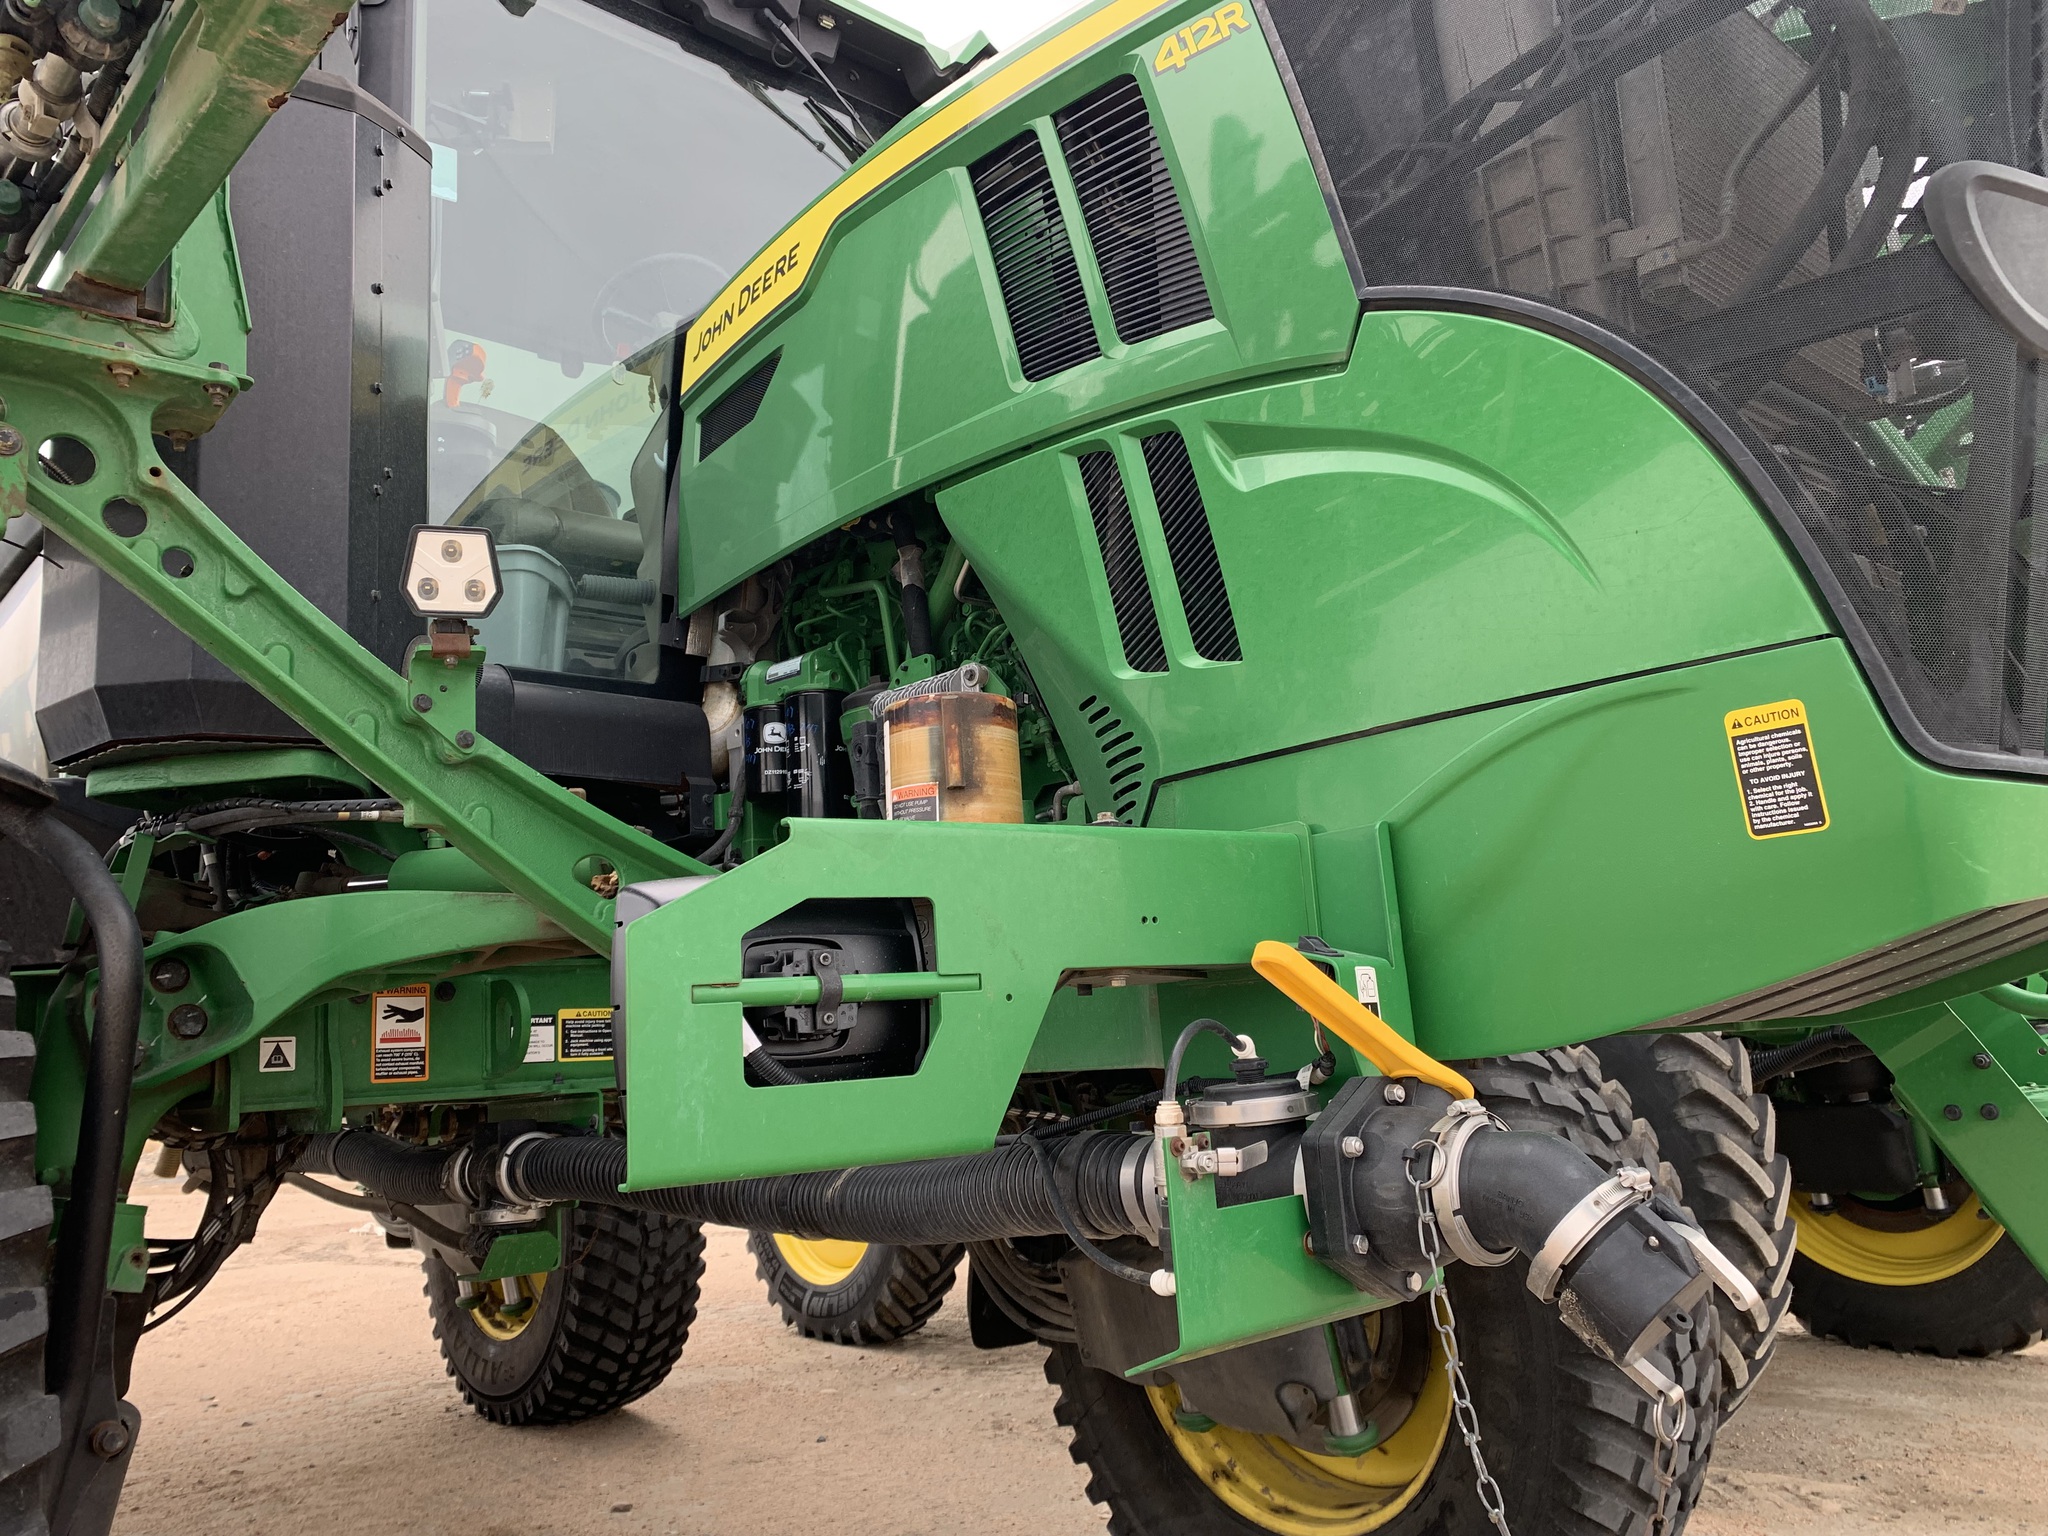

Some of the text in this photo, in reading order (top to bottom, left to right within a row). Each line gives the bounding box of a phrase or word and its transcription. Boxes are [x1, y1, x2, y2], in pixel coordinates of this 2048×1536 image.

[1152, 2, 1251, 77] 412R
[693, 242, 800, 363] JOHN DEERE
[1744, 707, 1799, 727] CAUTION
[1736, 729, 1802, 746] Agricultural chemicals
[1757, 737, 1791, 747] dangerous.
[754, 746, 773, 754] JOHN
[1766, 743, 1793, 752] selection
[1763, 751, 1780, 760] injure
[1766, 761, 1794, 771] property.
[1760, 775, 1780, 783] AVOID
[1781, 770, 1806, 779] INJURY
[897, 786, 935, 799] WARNING
[1753, 786, 1772, 794] Select
[1747, 792, 1774, 801] chemical
[1756, 797, 1776, 806] Handle
[1780, 800, 1800, 808] Follow
[908, 806, 932, 814] PRESSURE
[1751, 804, 1809, 818] instructions issued
[1772, 812, 1799, 820] chemical
[1754, 819, 1796, 829] manufacturer.
[387, 986, 426, 994] WARNING
